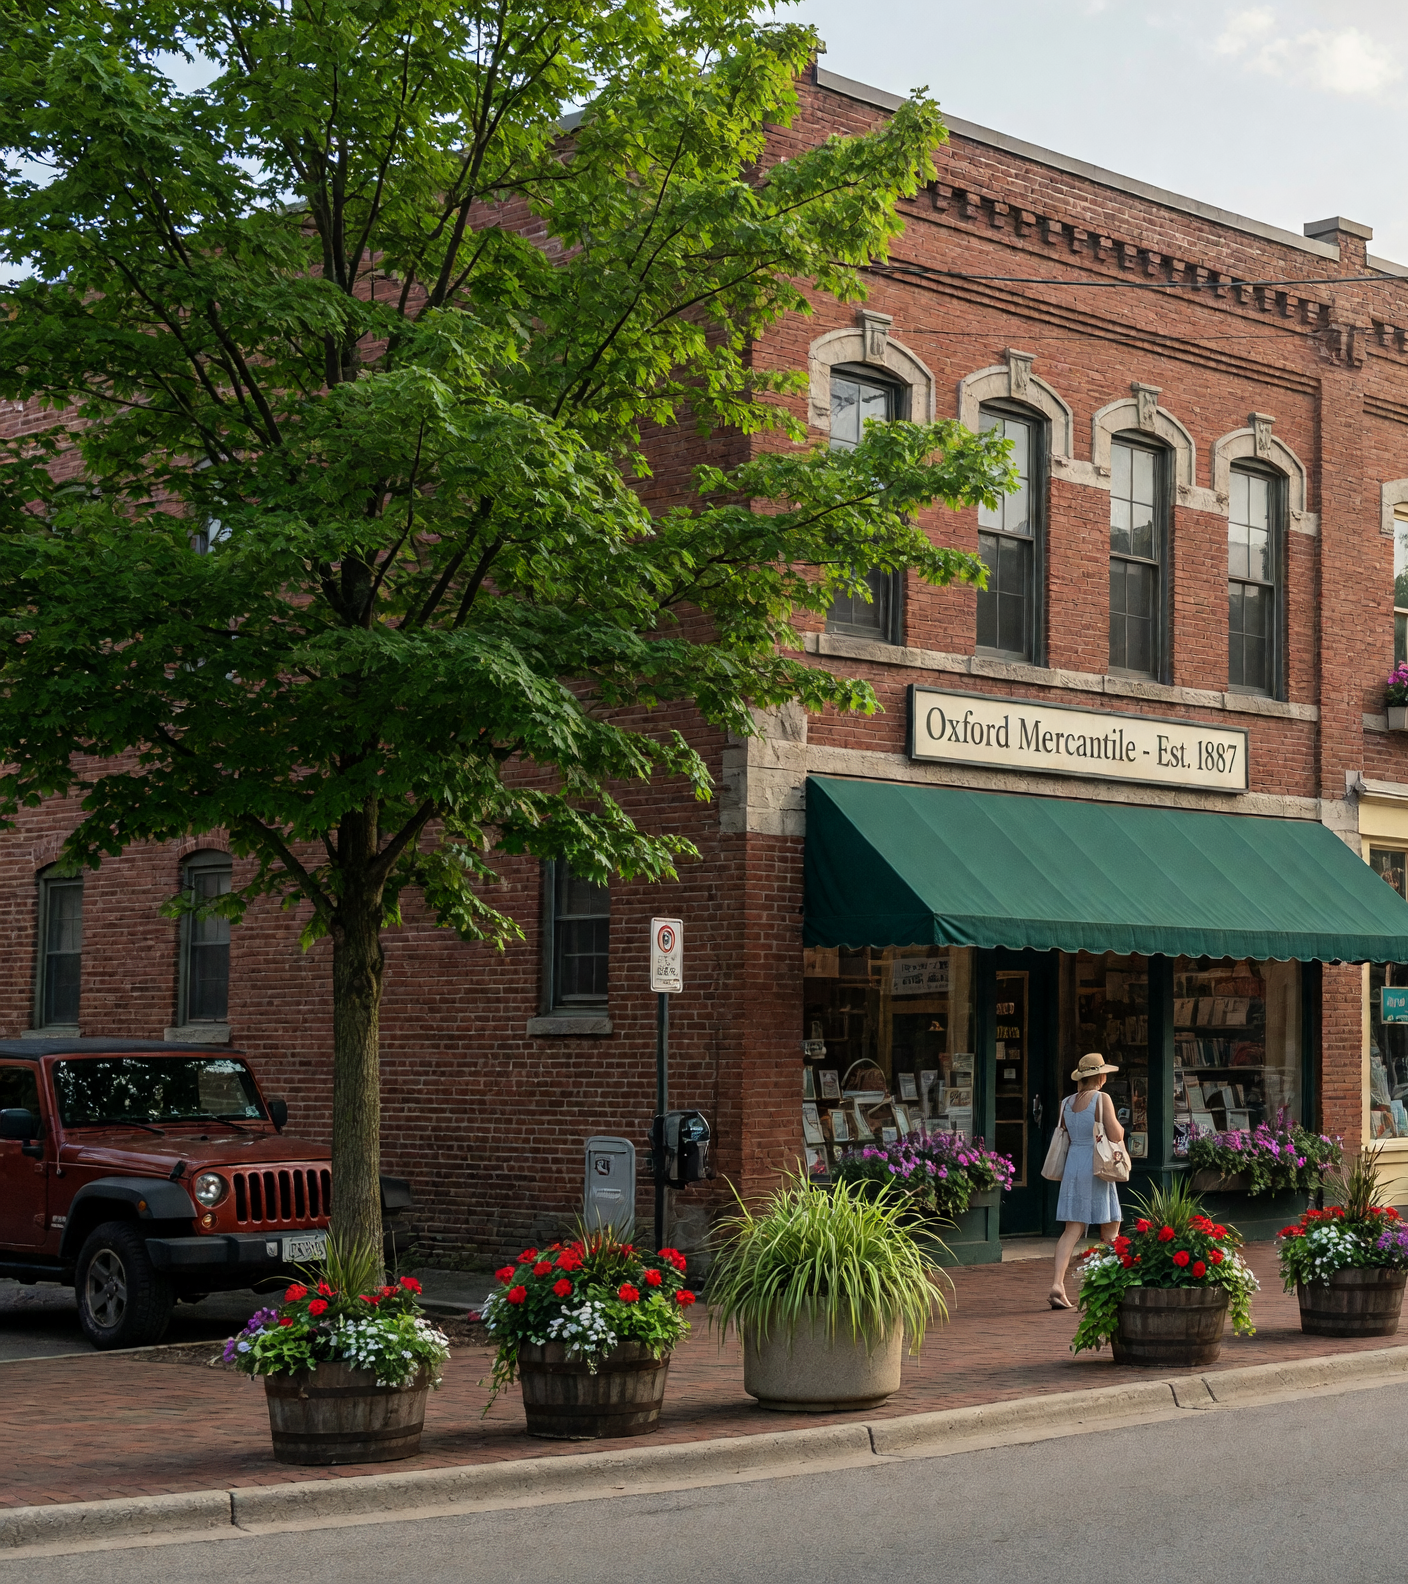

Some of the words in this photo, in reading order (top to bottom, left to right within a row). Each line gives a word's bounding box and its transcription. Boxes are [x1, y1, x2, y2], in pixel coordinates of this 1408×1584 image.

[926, 706, 1010, 749] Oxford
[1018, 717, 1136, 762] Mercantile
[1157, 734, 1191, 769] Est.
[1197, 740, 1237, 774] 1887
